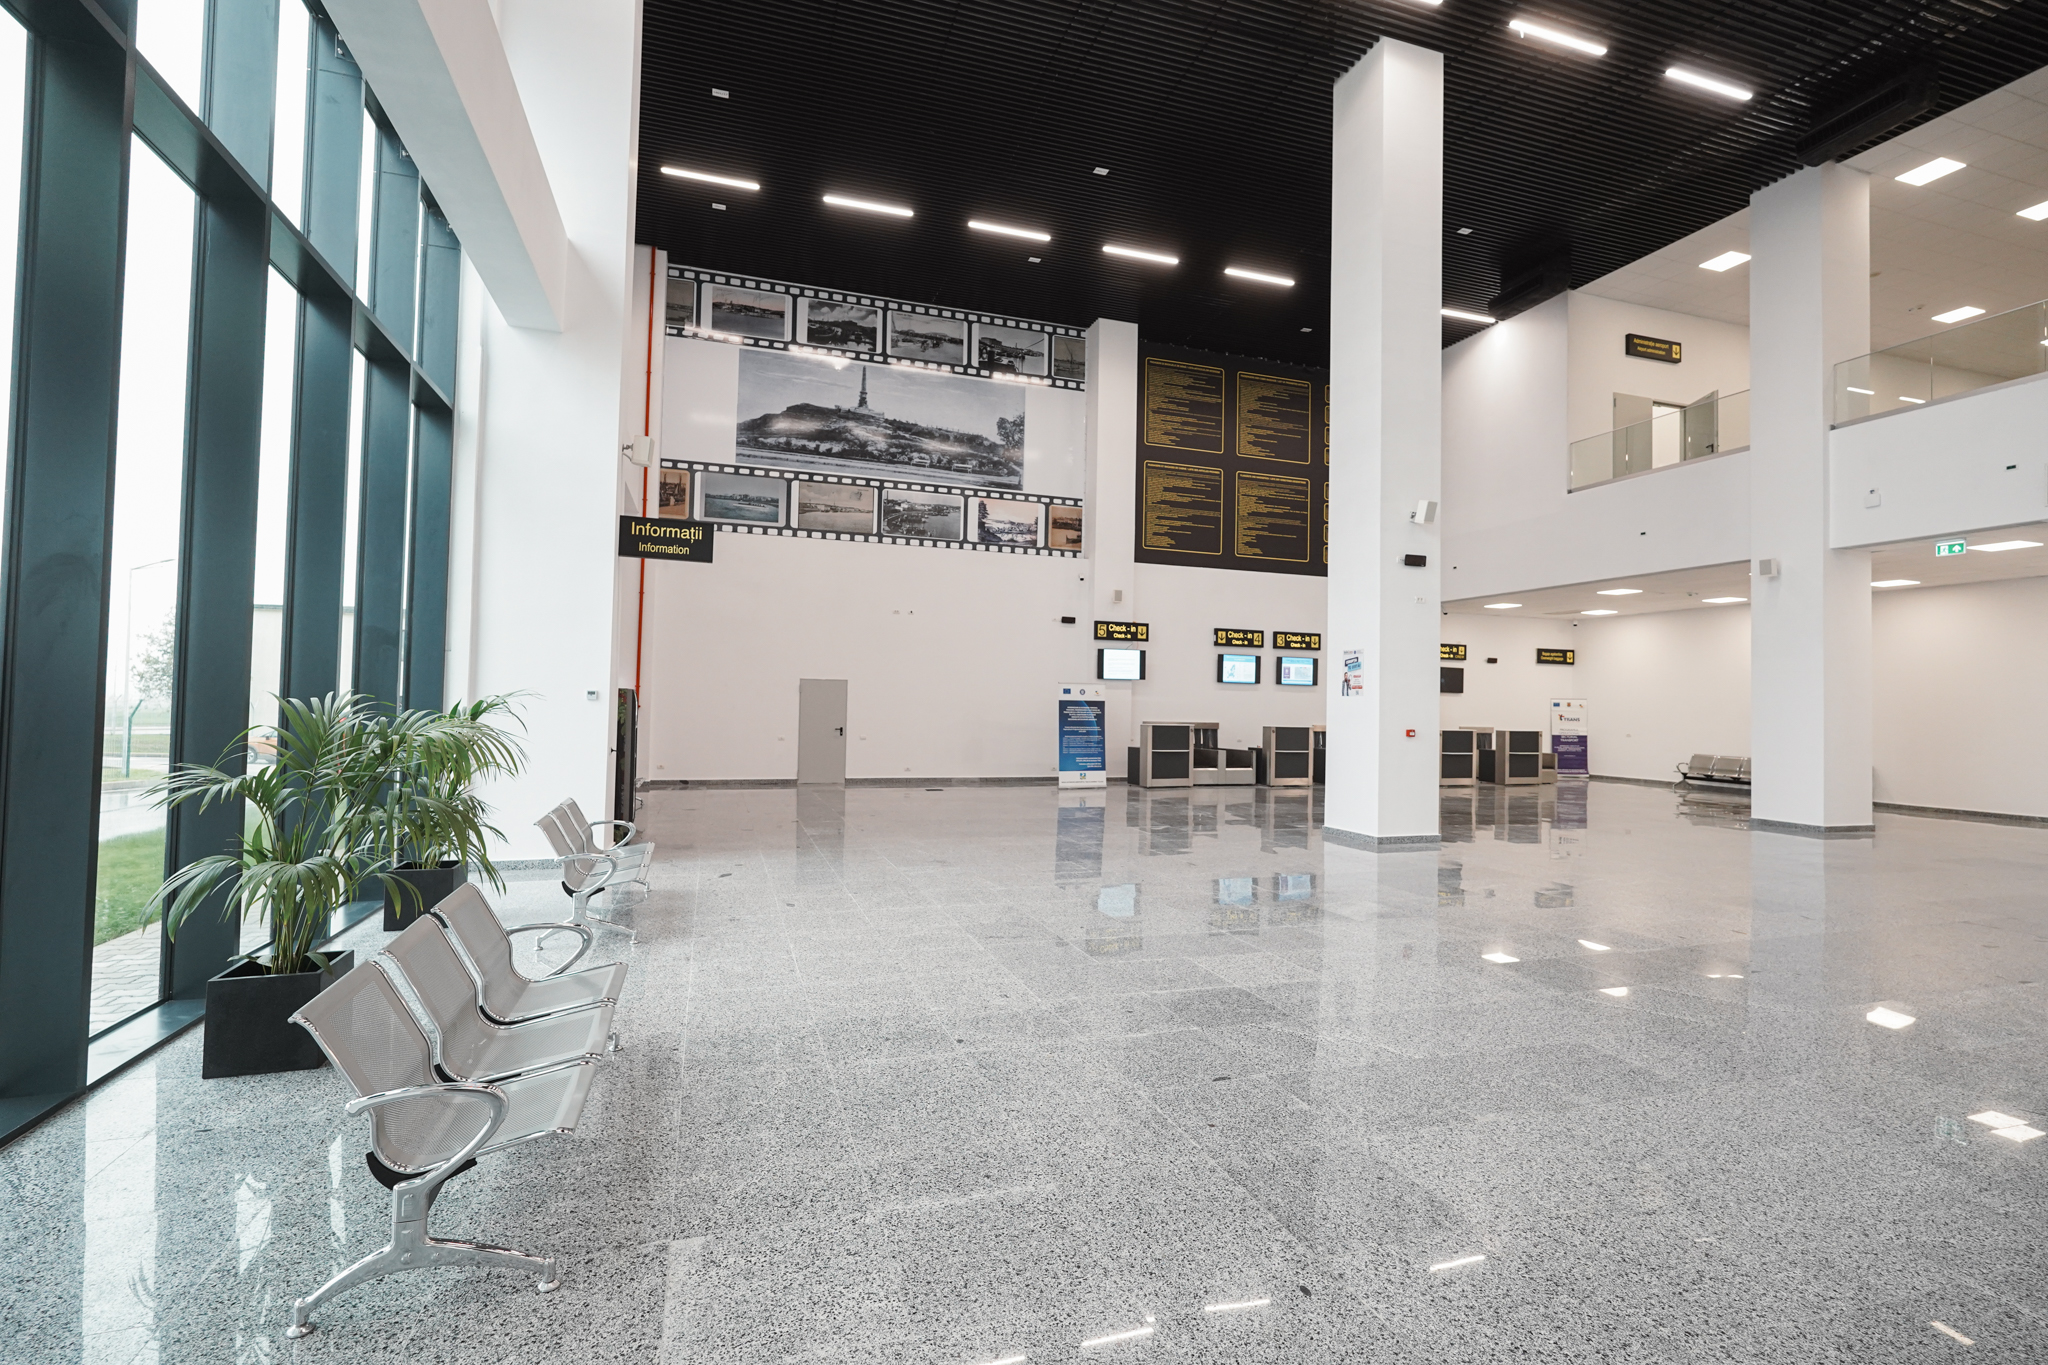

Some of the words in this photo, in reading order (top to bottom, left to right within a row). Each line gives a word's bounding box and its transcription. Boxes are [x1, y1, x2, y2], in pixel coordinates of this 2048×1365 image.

[631, 521, 703, 543] Informații
[638, 542, 690, 555] Information
[1098, 625, 1106, 637] 5
[1254, 634, 1261, 644] 4
[1277, 635, 1284, 646] 3
